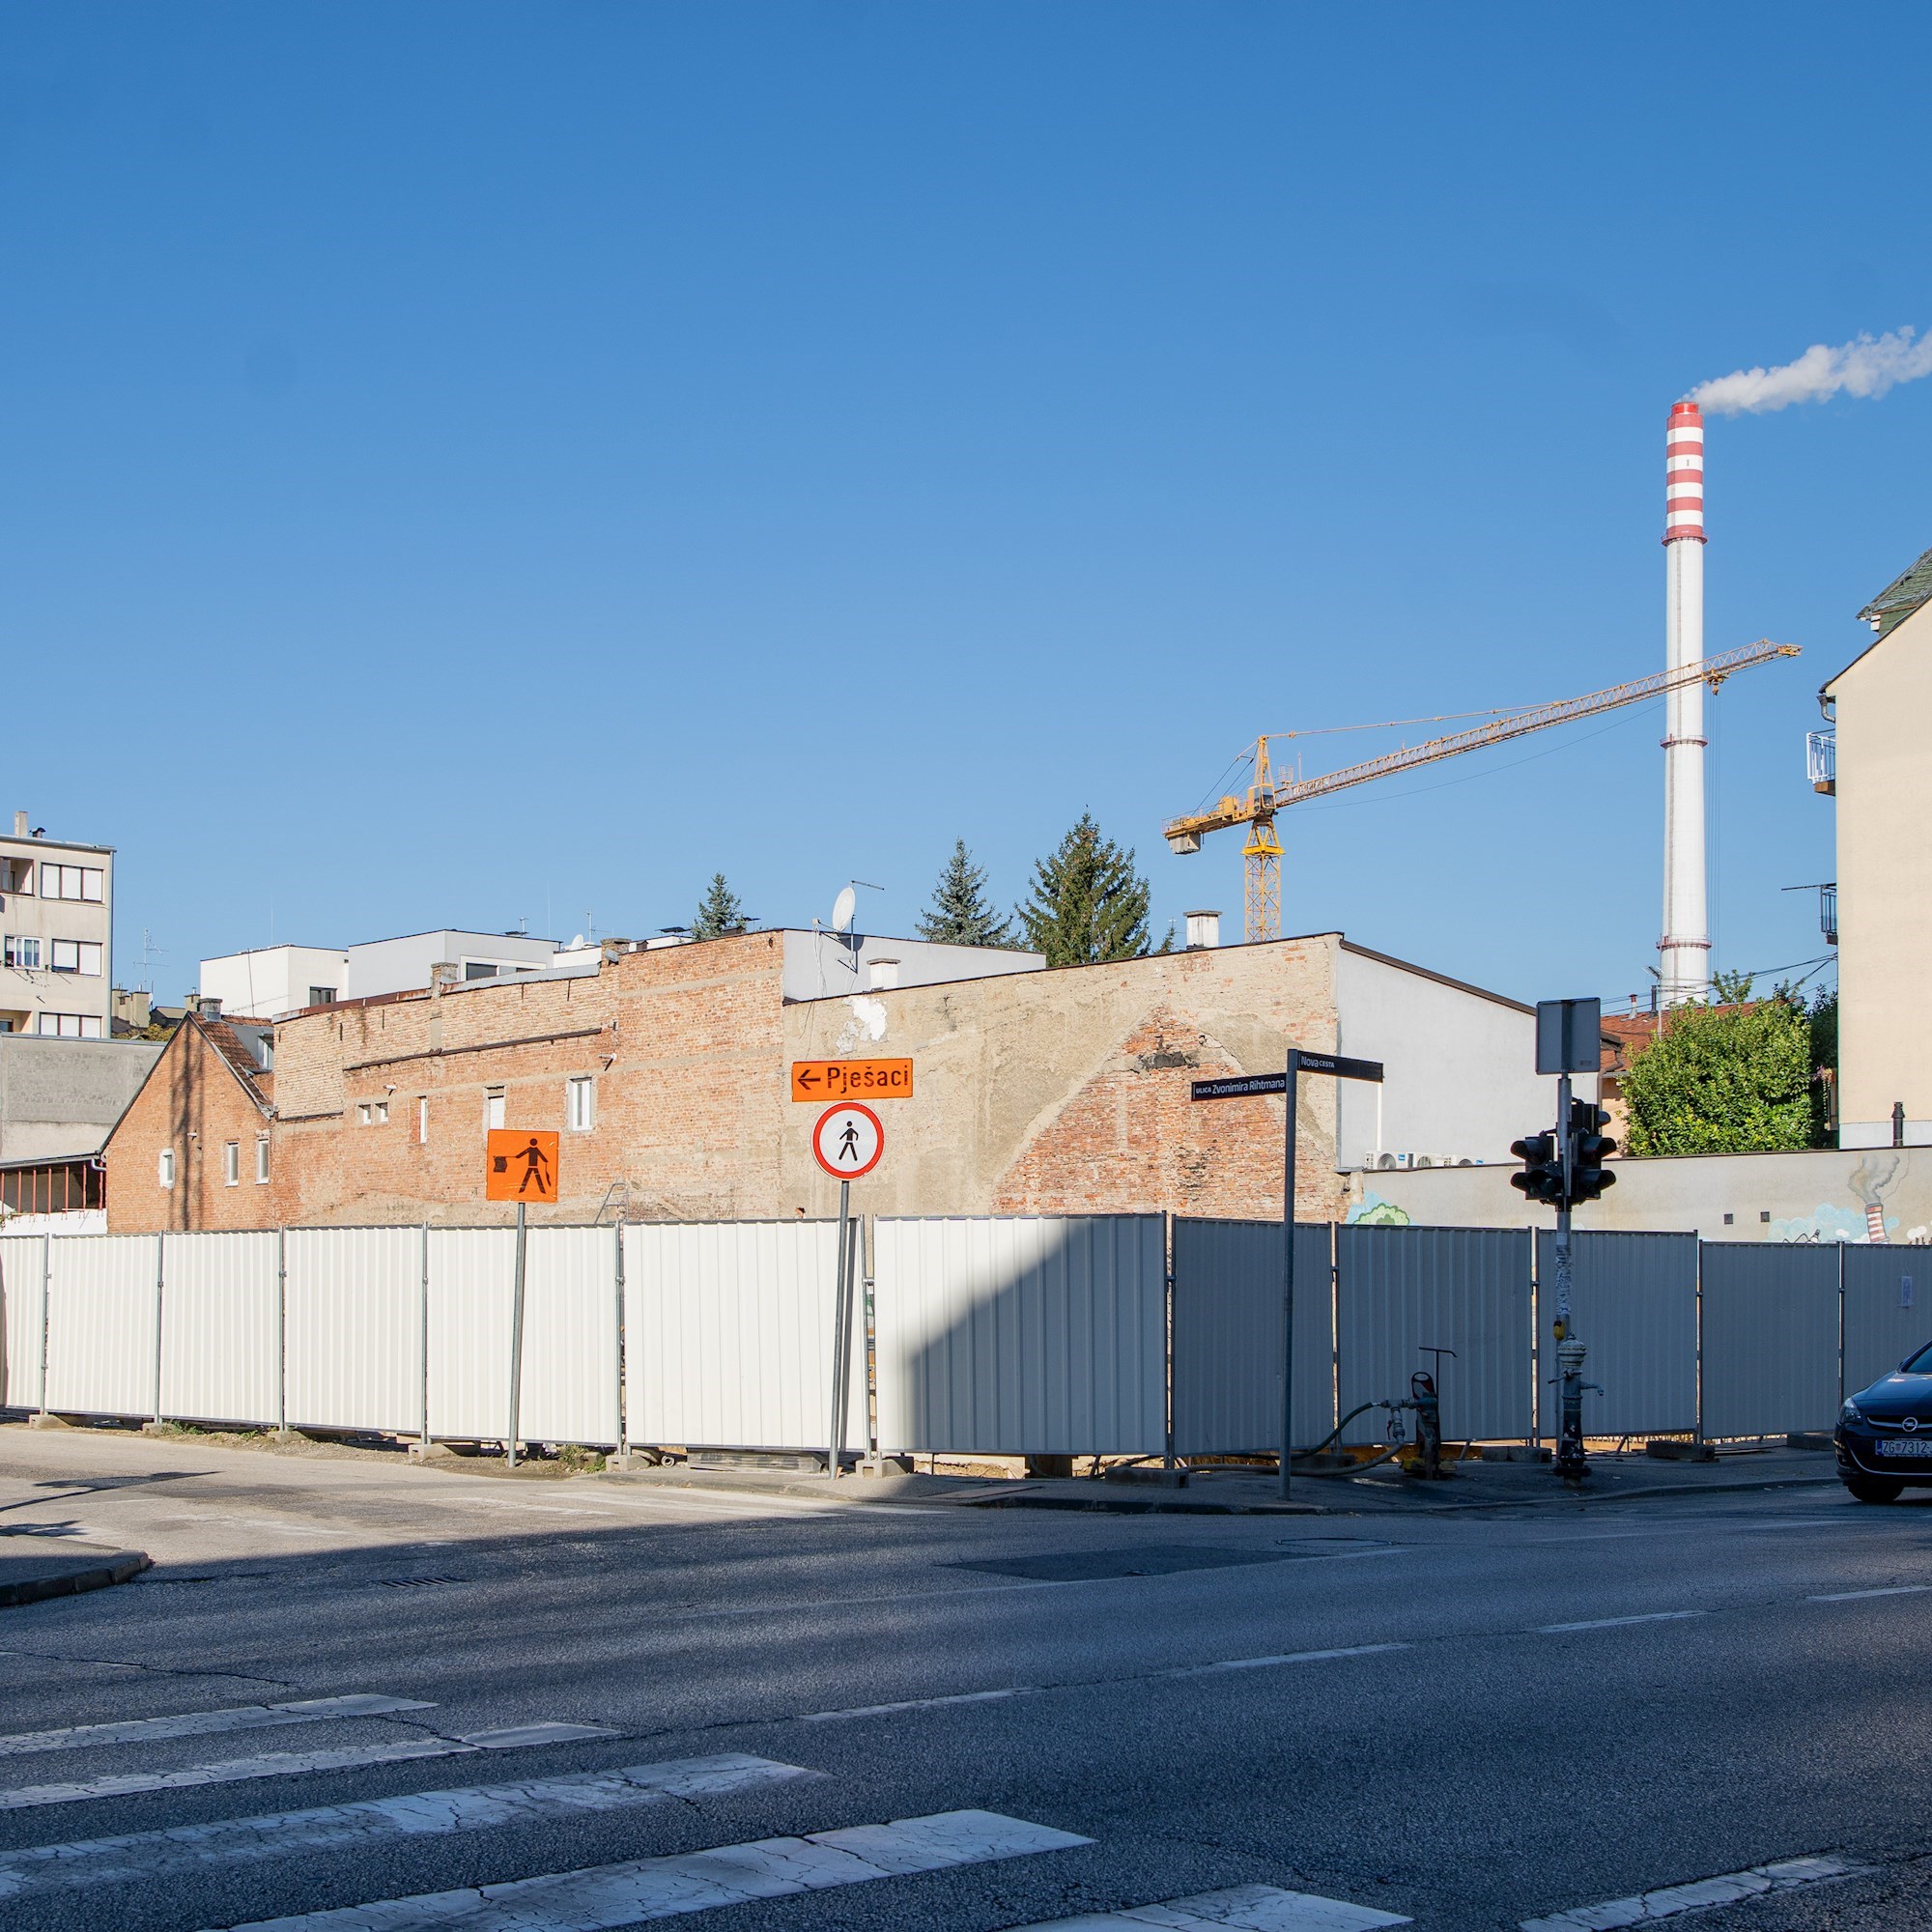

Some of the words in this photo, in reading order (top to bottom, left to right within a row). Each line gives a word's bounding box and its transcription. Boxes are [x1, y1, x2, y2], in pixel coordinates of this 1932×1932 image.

[1300, 1055, 1319, 1067] Nova
[827, 1065, 909, 1094] Pješaci
[1211, 1082, 1249, 1094] Zvonimira
[1249, 1079, 1285, 1092] Rihtmana
[1883, 1441, 1895, 1454] ZG
